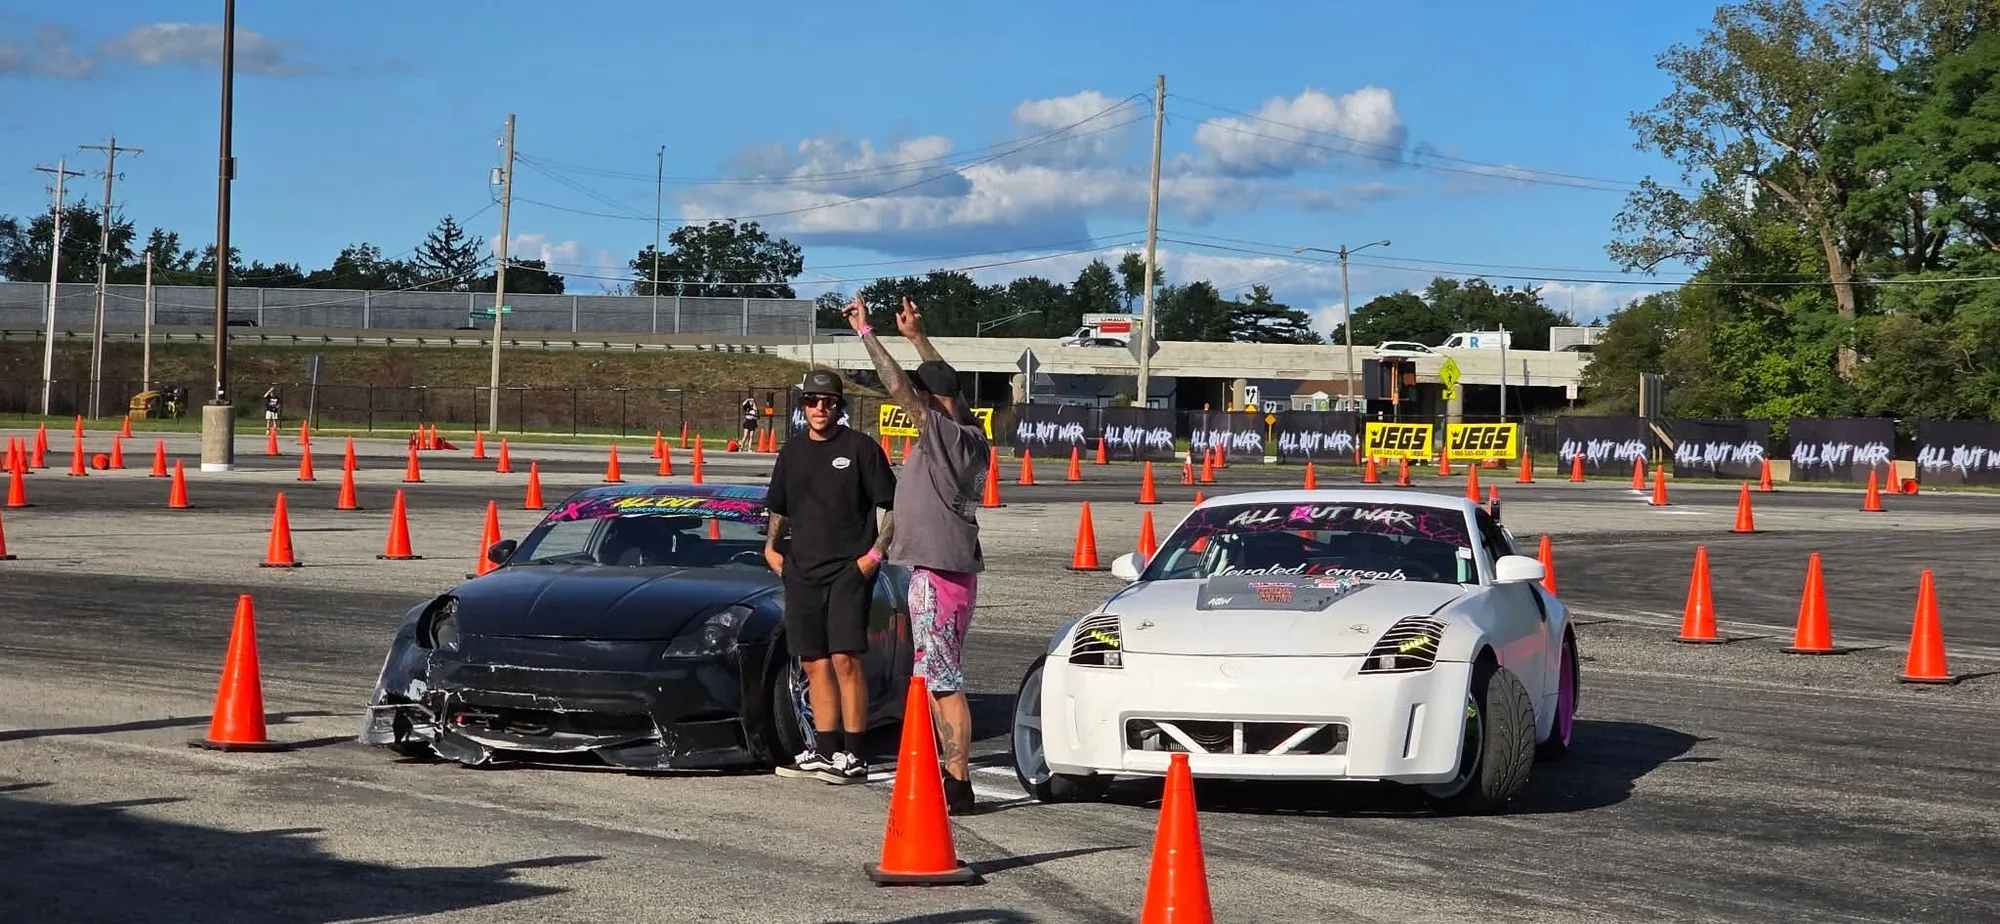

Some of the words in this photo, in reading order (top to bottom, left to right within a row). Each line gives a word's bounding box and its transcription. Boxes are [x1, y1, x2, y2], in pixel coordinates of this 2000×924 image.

[882, 407, 914, 428] JEG
[1017, 419, 1035, 445] ALL
[1036, 421, 1058, 447] OUT
[1059, 422, 1086, 445] WAR
[1104, 424, 1122, 448] ALL
[1123, 425, 1145, 451] OUT
[1145, 426, 1174, 450] WAR
[1191, 428, 1207, 450] ALL
[1232, 430, 1263, 452] WAR
[1279, 430, 1299, 453] ALL
[1300, 430, 1323, 458] OUT
[1324, 430, 1355, 454] WAR
[1370, 427, 1429, 449] JEGS
[1451, 427, 1511, 449] JEGS
[1559, 438, 1586, 461] ALL
[1586, 438, 1614, 468] OUT
[1614, 438, 1647, 464] WAR
[1675, 441, 1702, 467] ALL
[1703, 441, 1732, 472] OUT
[1732, 441, 1765, 467] WAR
[1791, 441, 1820, 469] ALL
[1820, 441, 1853, 473] OUT
[1853, 441, 1892, 468] WAR
[1917, 444, 1950, 474] ALL
[1951, 444, 1987, 478] OUT
[610, 497, 655, 507] ALL
[656, 498, 708, 507] OUT
[1227, 508, 1283, 526] ALL
[1288, 505, 1351, 523] OUT
[1353, 508, 1415, 529] WAR
